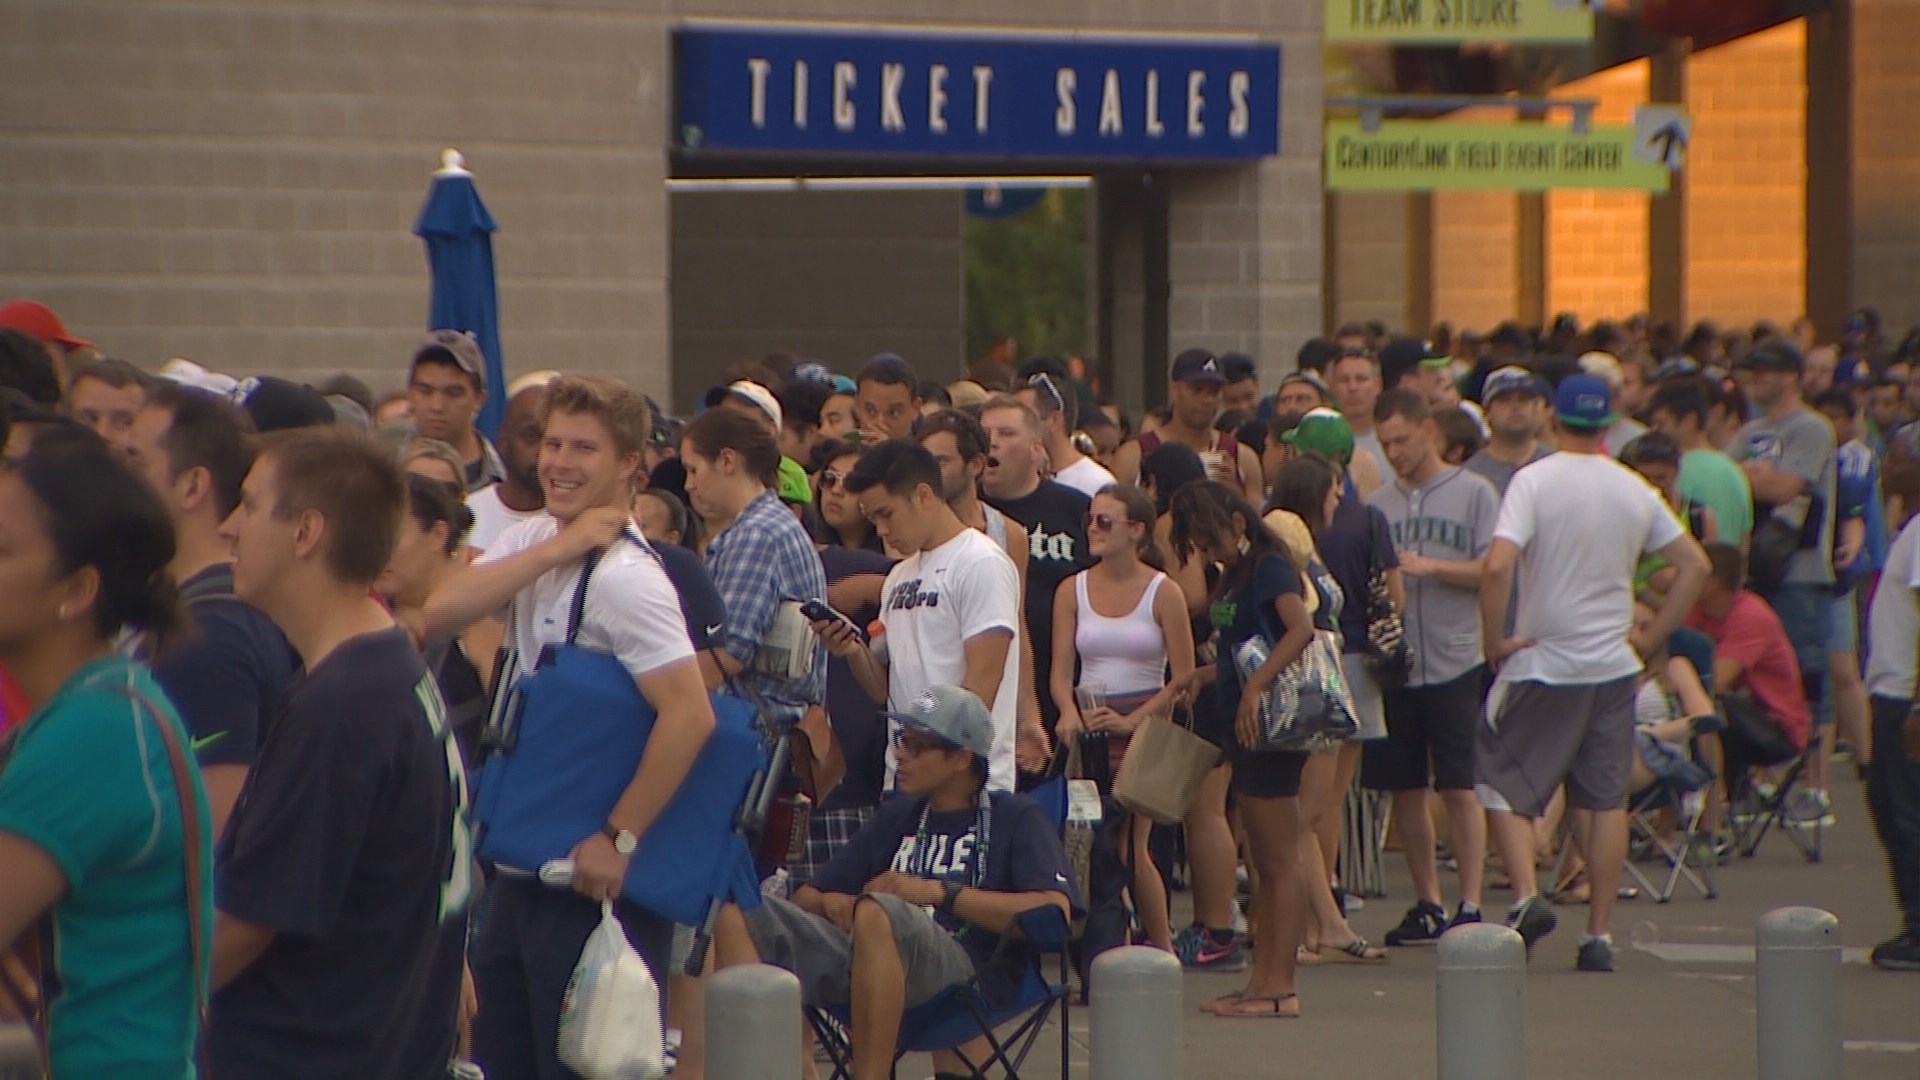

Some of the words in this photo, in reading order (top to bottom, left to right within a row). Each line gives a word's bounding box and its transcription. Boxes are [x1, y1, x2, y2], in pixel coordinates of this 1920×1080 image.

[1349, 0, 1421, 26] TEAM
[1434, 0, 1519, 27] STORE
[748, 58, 993, 135] TICKET
[1055, 67, 1250, 140] SALES
[1563, 141, 1623, 170] CENTER
[1023, 521, 1075, 562] ta
